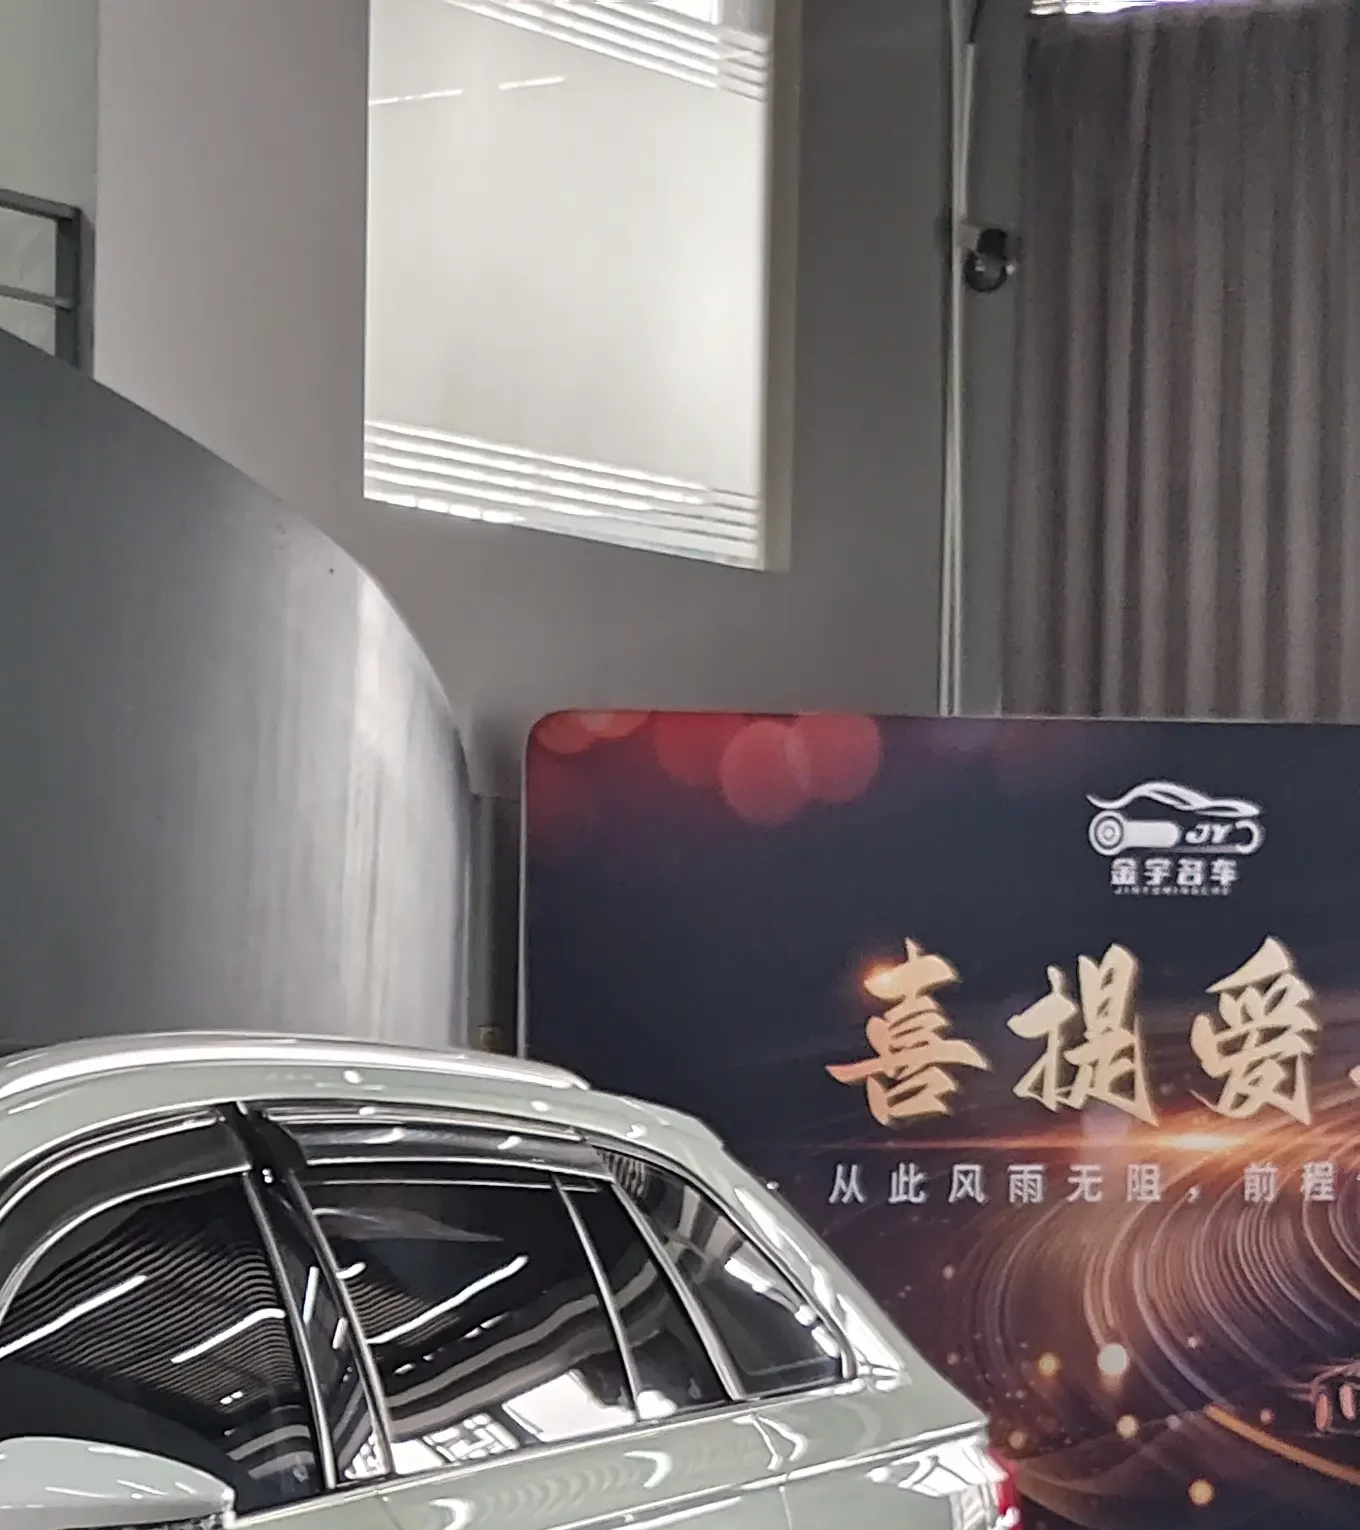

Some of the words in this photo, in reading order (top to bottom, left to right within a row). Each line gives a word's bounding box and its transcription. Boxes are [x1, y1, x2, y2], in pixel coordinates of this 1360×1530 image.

[825, 936, 1360, 1128] 喜提爱
[828, 1161, 1360, 1205] 从此风雨无阻，前程
